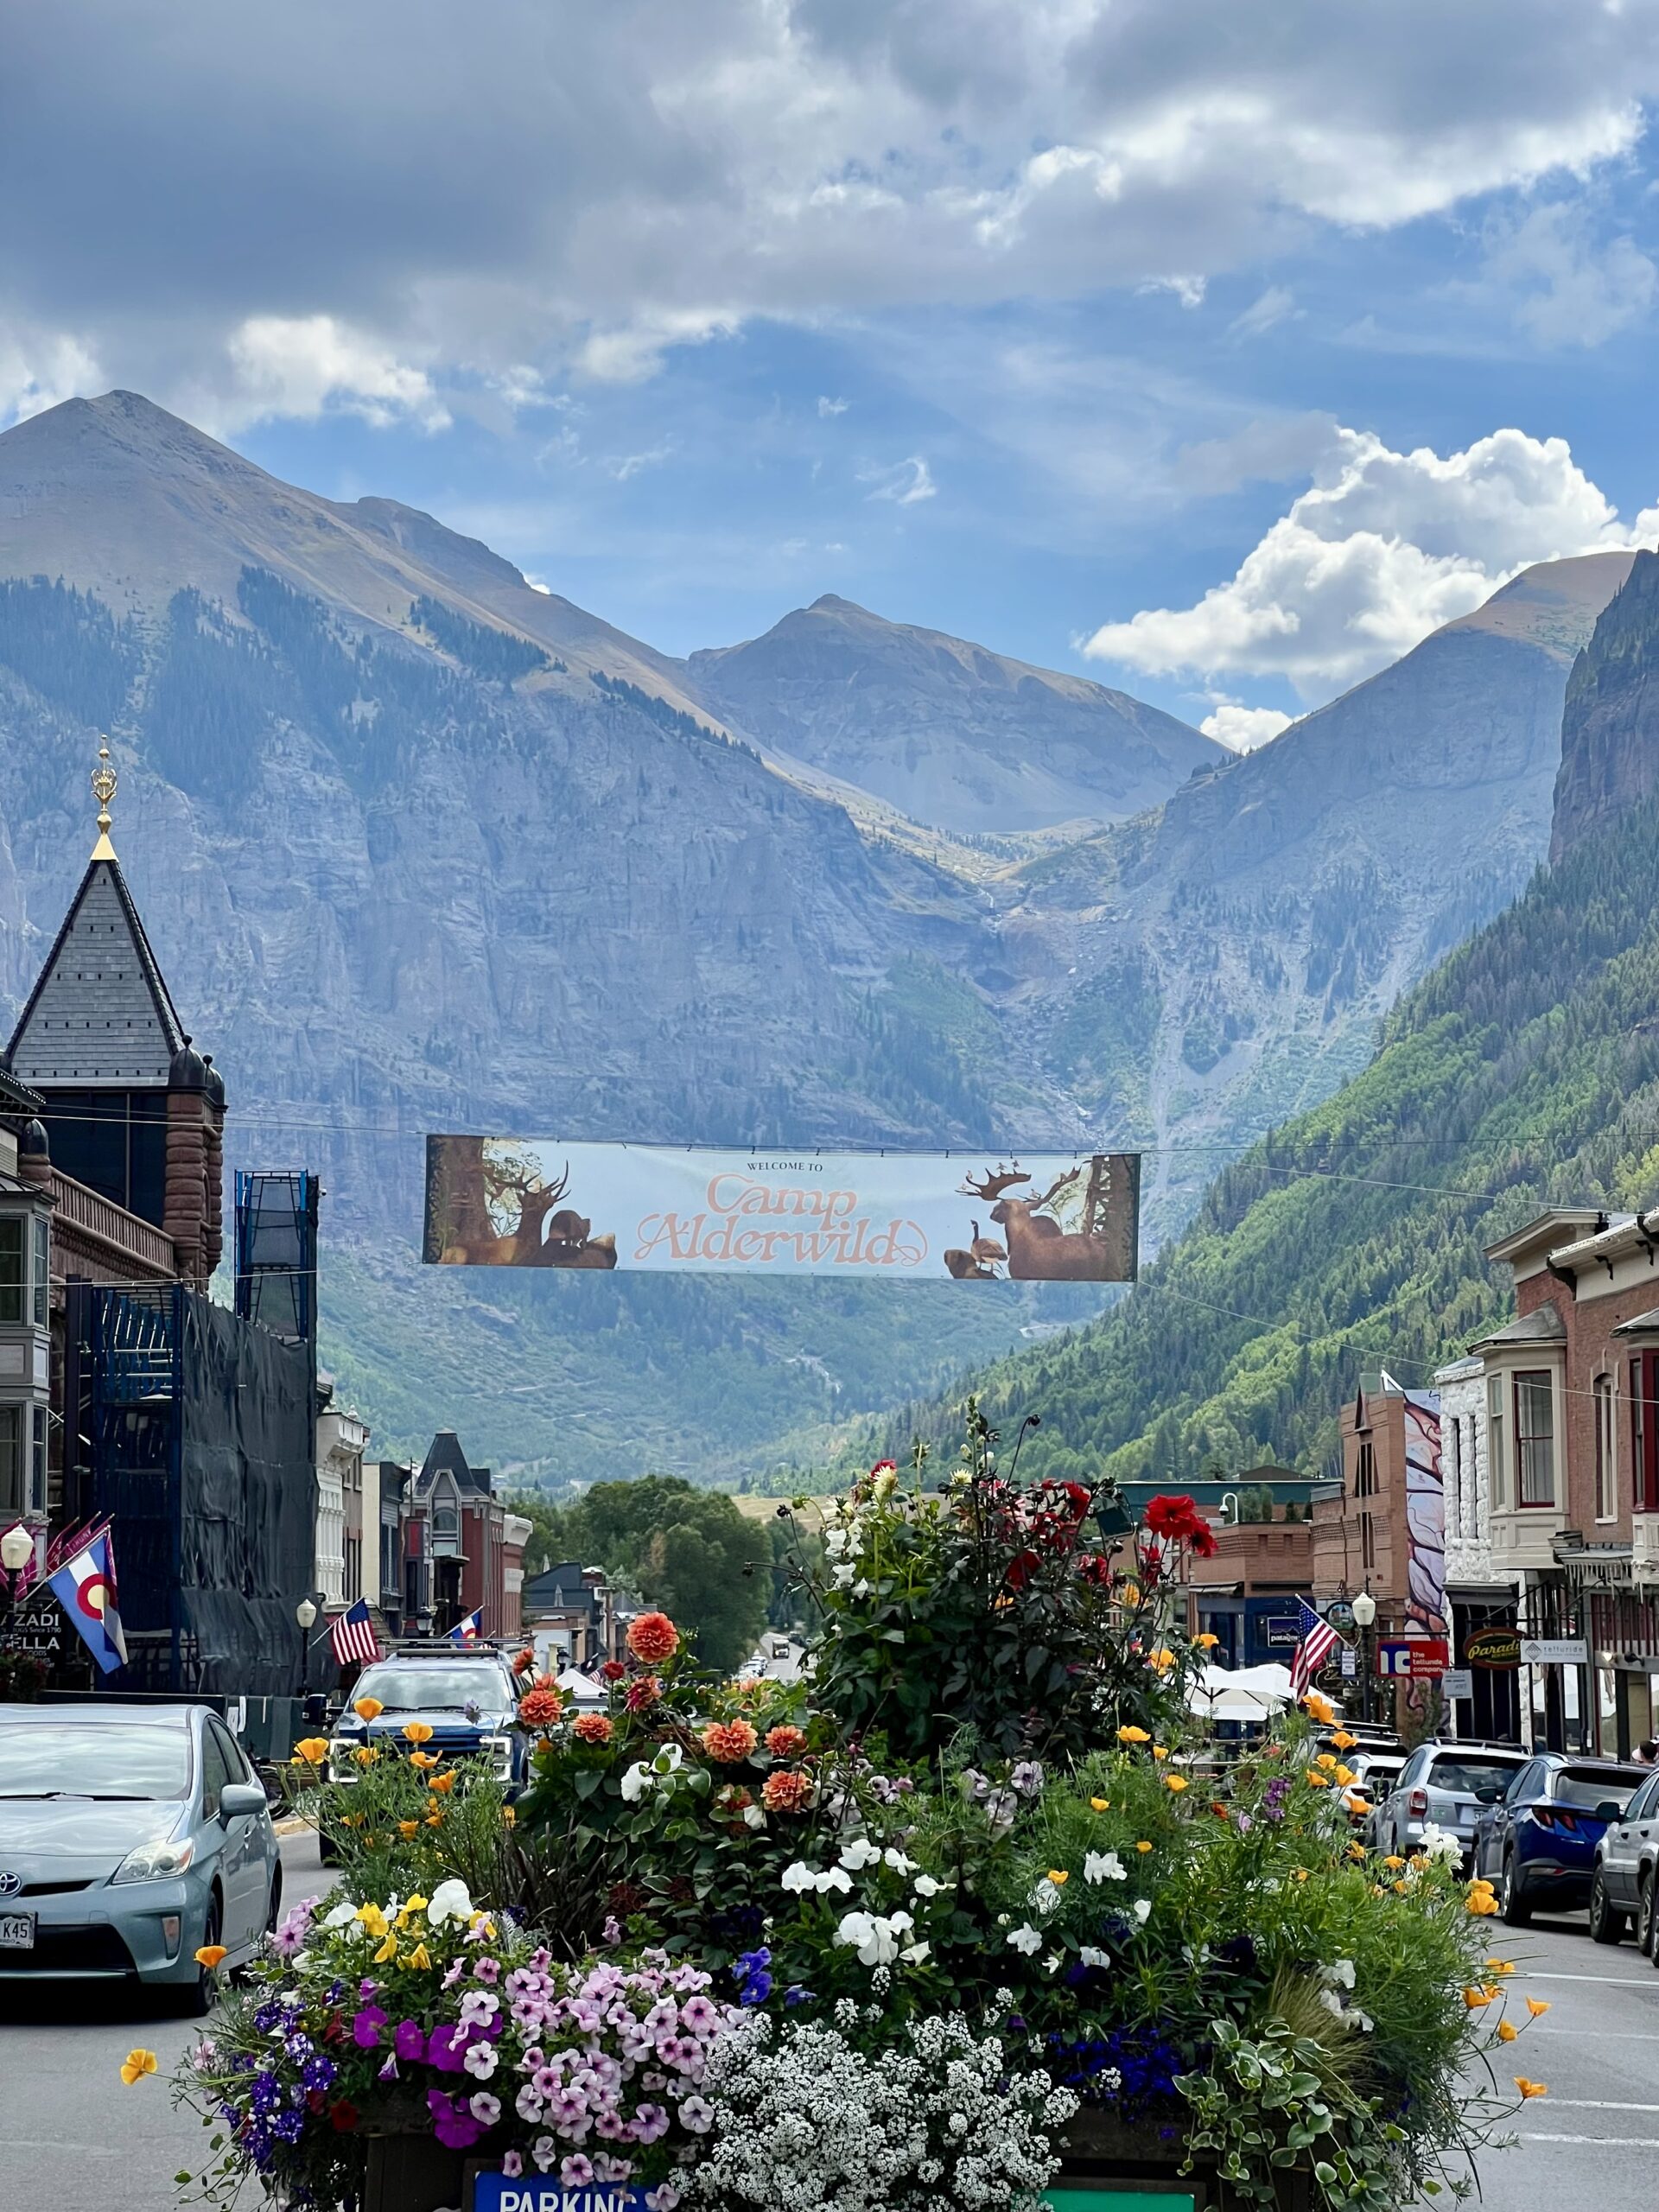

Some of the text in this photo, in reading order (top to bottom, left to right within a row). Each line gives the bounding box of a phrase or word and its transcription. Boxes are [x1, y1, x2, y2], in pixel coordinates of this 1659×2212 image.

[808, 1163, 823, 1172] TO
[705, 1172, 859, 1232] Camp
[633, 1211, 929, 1268] Alderwild
[1468, 1639, 1520, 1659] Paradi
[3, 1923, 28, 1938] K45
[499, 2191, 637, 2212] PARKIN
